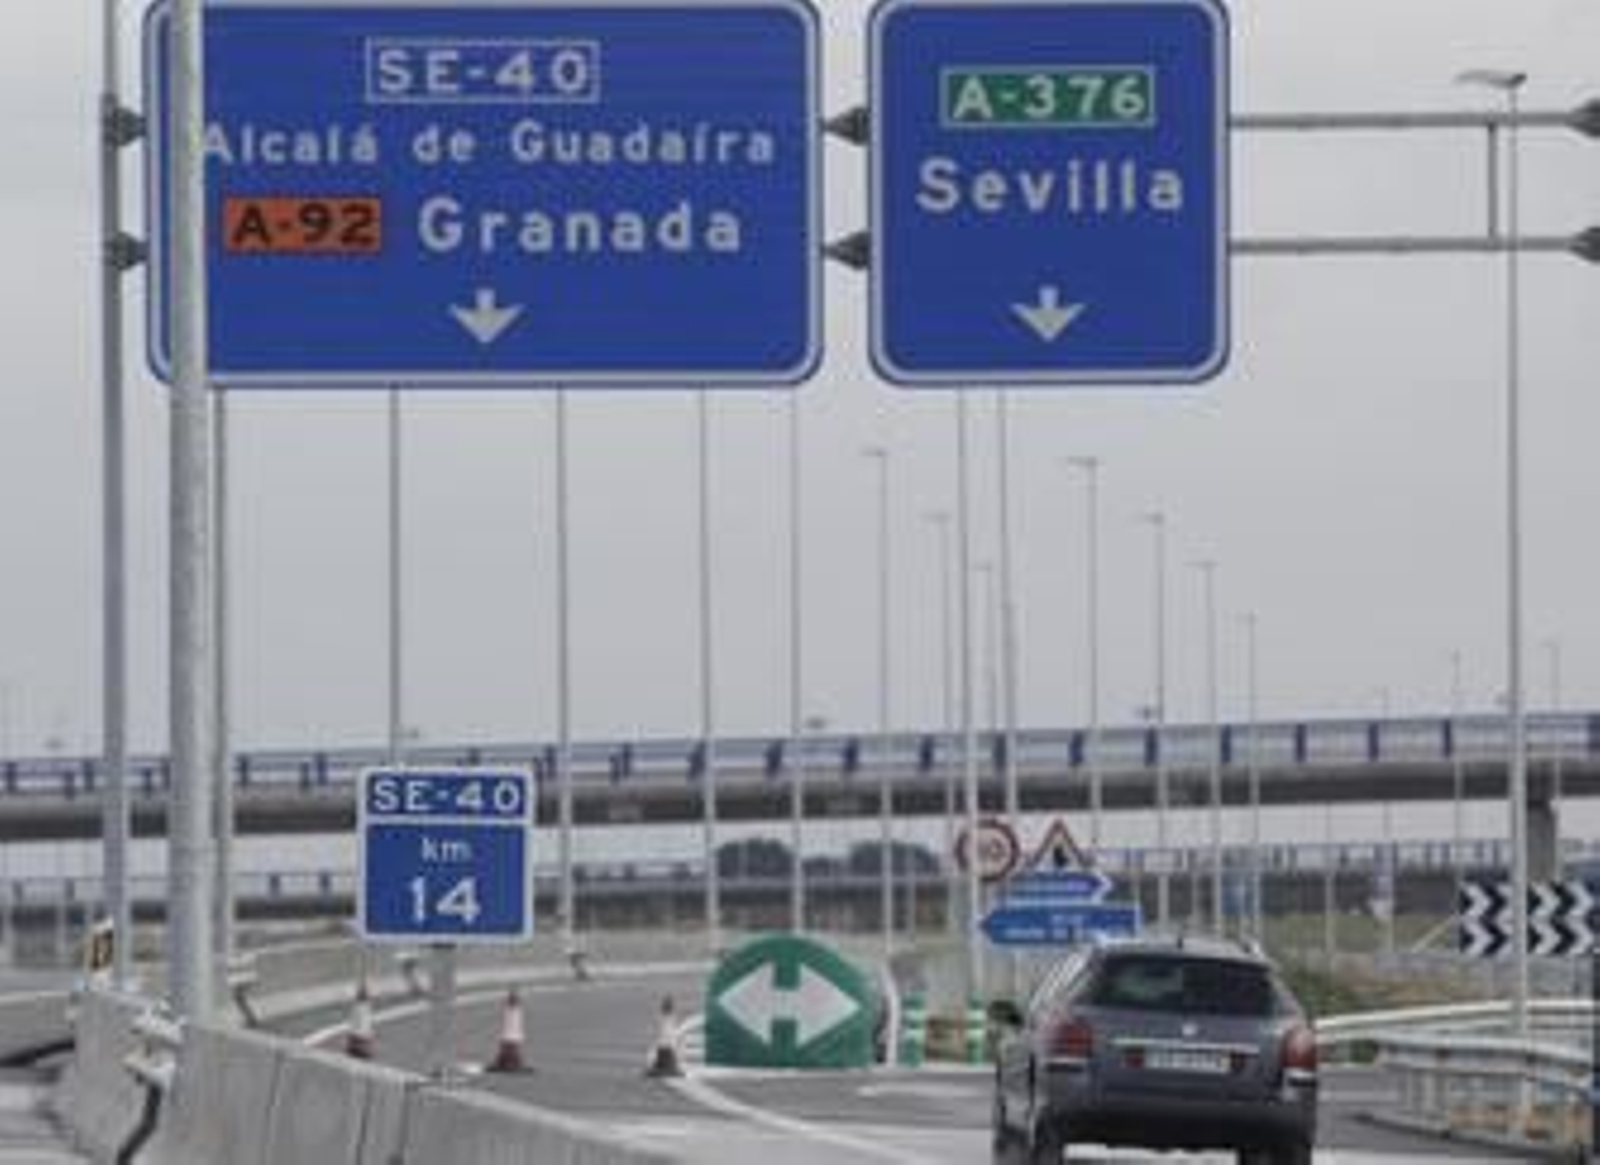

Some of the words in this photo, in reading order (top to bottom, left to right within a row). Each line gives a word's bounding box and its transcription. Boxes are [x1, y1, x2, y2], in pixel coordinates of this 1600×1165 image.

[376, 50, 589, 92] SE-40
[953, 74, 1146, 120] A-376
[203, 121, 378, 164] Alcalá
[412, 122, 476, 164] de
[511, 120, 775, 164] Guadaíra
[915, 157, 1184, 212] Sevilla
[230, 202, 377, 246] A-92
[418, 197, 741, 252] Granada
[373, 779, 521, 811] SE-40
[421, 838, 473, 862] km
[411, 877, 481, 923] 14
